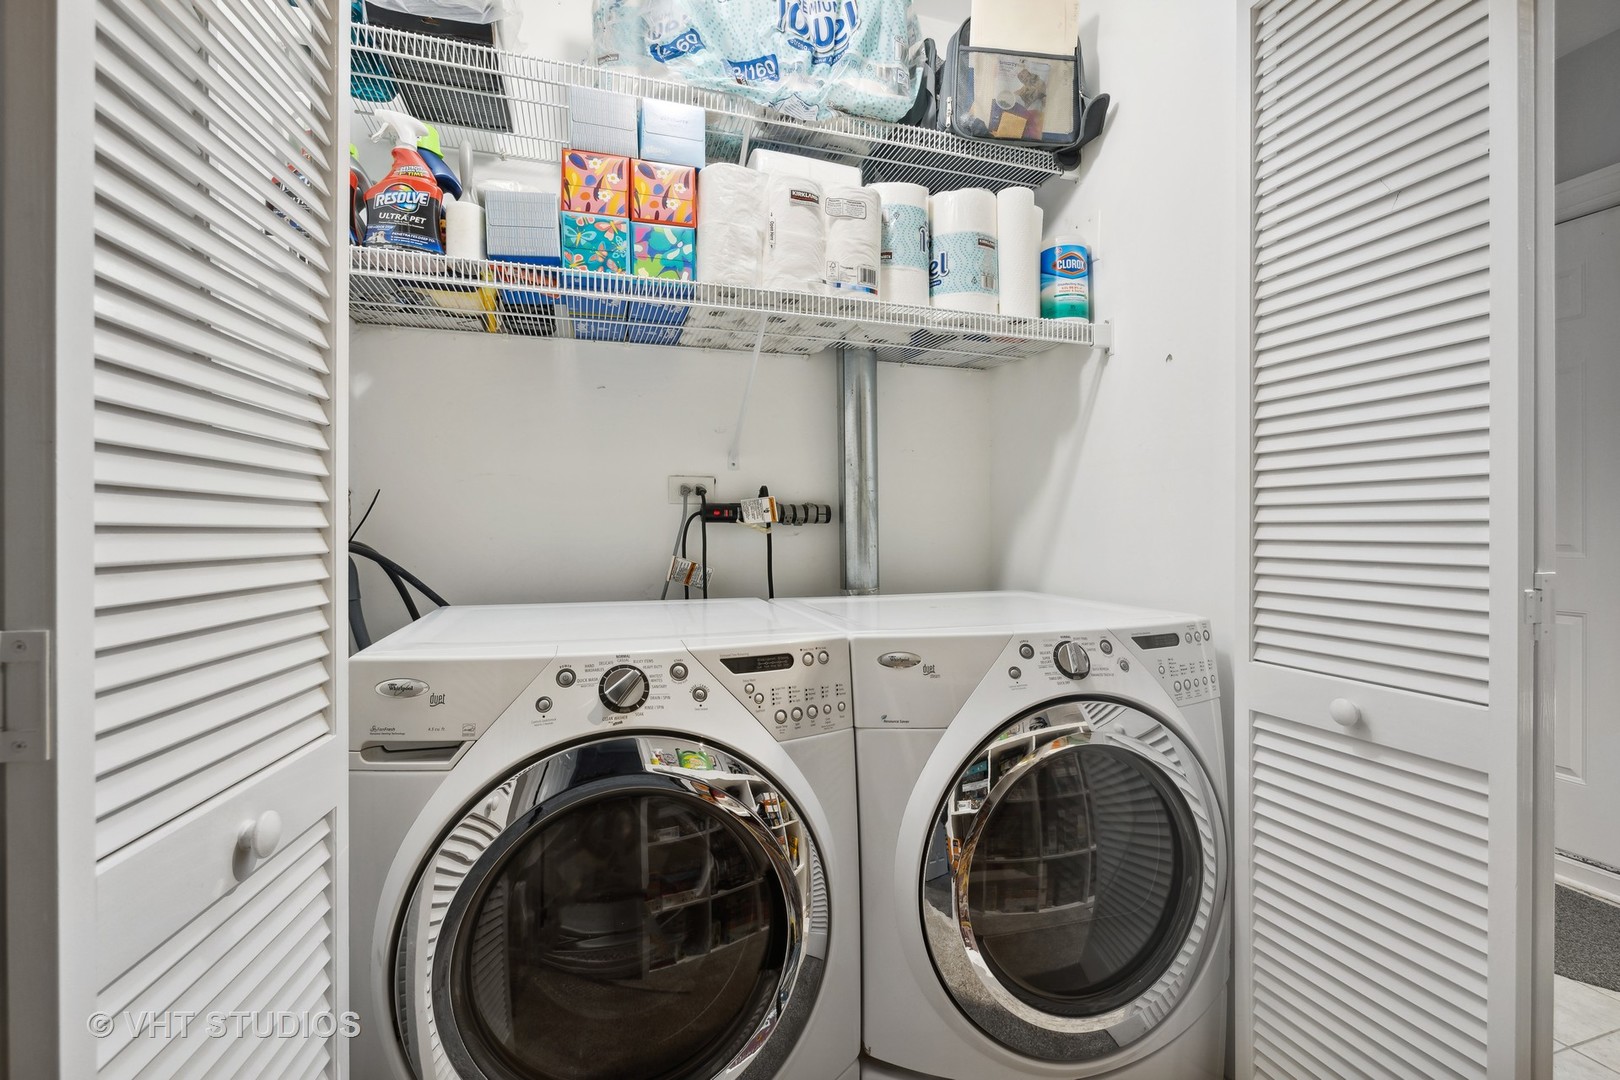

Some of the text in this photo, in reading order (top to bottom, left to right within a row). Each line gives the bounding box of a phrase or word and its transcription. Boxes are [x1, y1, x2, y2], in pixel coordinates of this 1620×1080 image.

[375, 192, 430, 207] RESOLVE
[379, 212, 408, 220] ULTRA
[409, 215, 427, 225] PET
[1057, 258, 1085, 270] CLOROX
[922, 664, 936, 676] duet
[429, 693, 446, 708] duet
